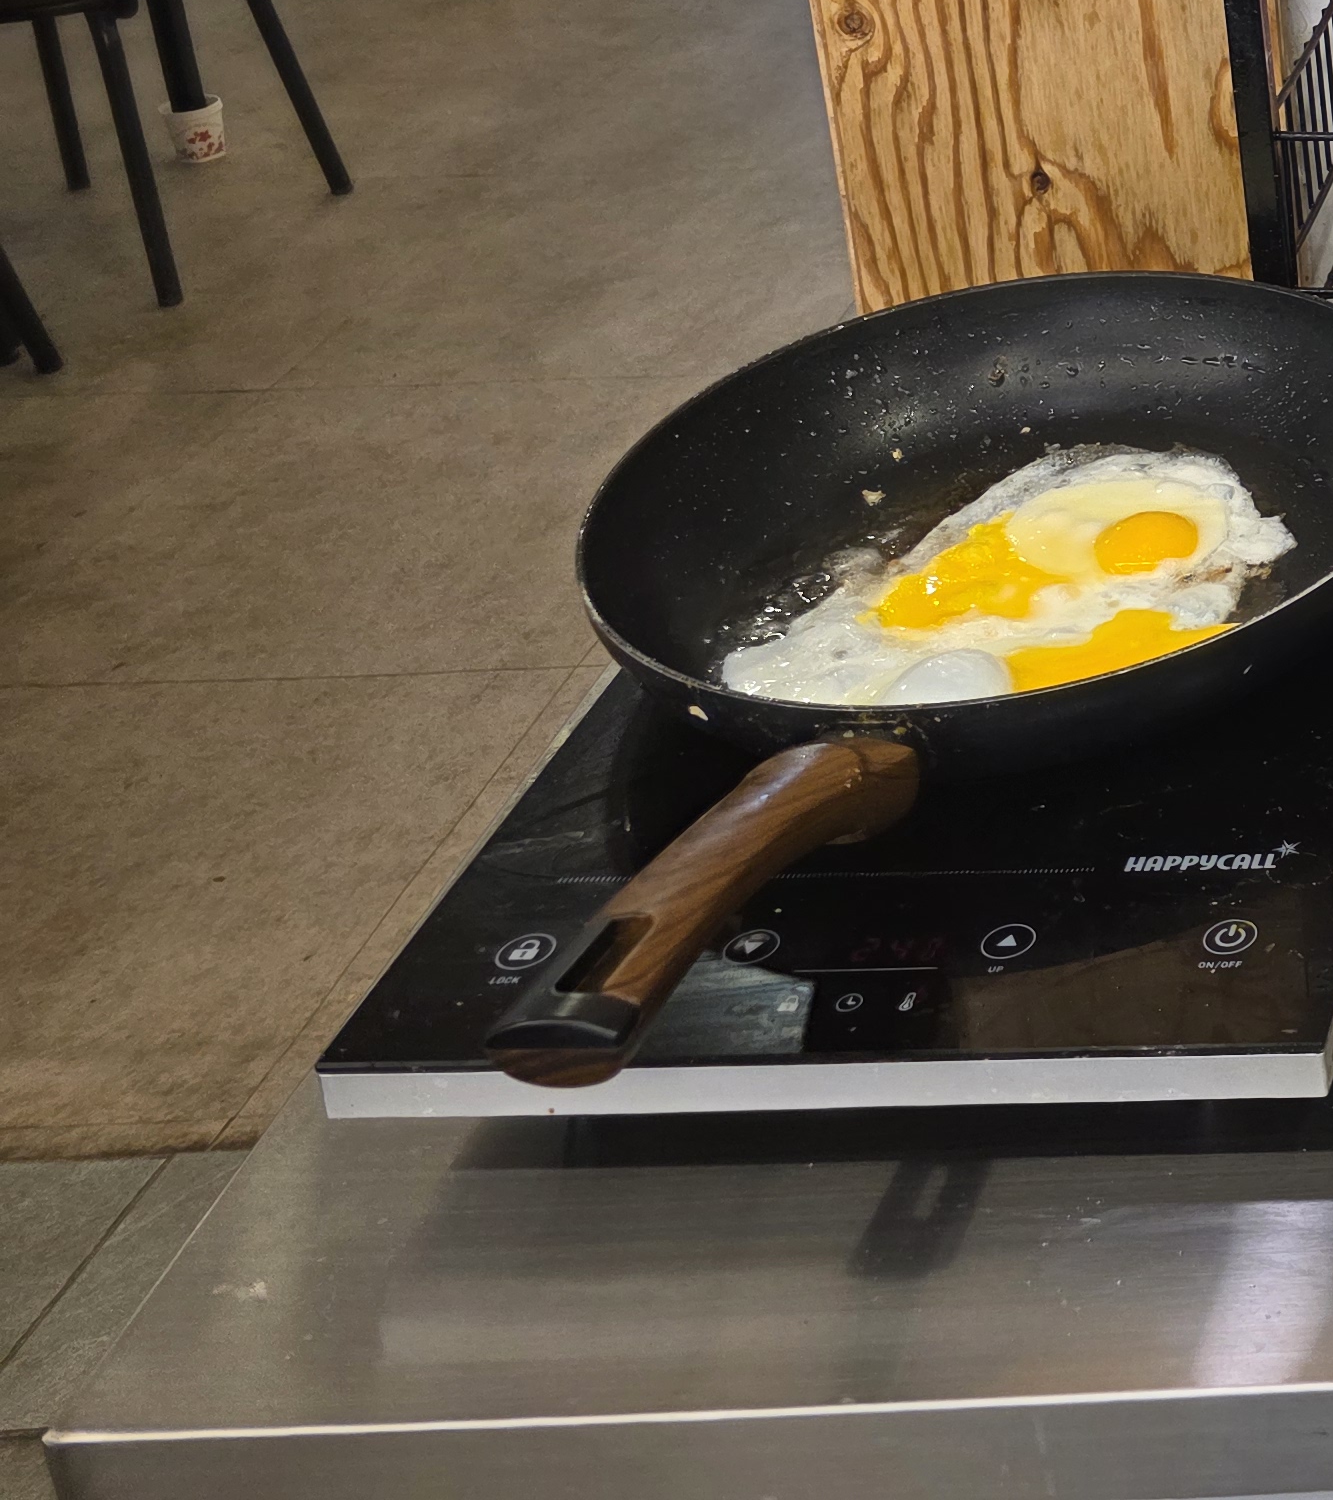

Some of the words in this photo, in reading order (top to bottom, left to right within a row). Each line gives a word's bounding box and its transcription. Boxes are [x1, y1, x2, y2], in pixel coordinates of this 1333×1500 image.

[1123, 853, 1277, 873] HAPPYCALL
[1197, 960, 1243, 969] ON/OFF
[987, 965, 1004, 974] UP
[488, 975, 522, 985] LOCK
